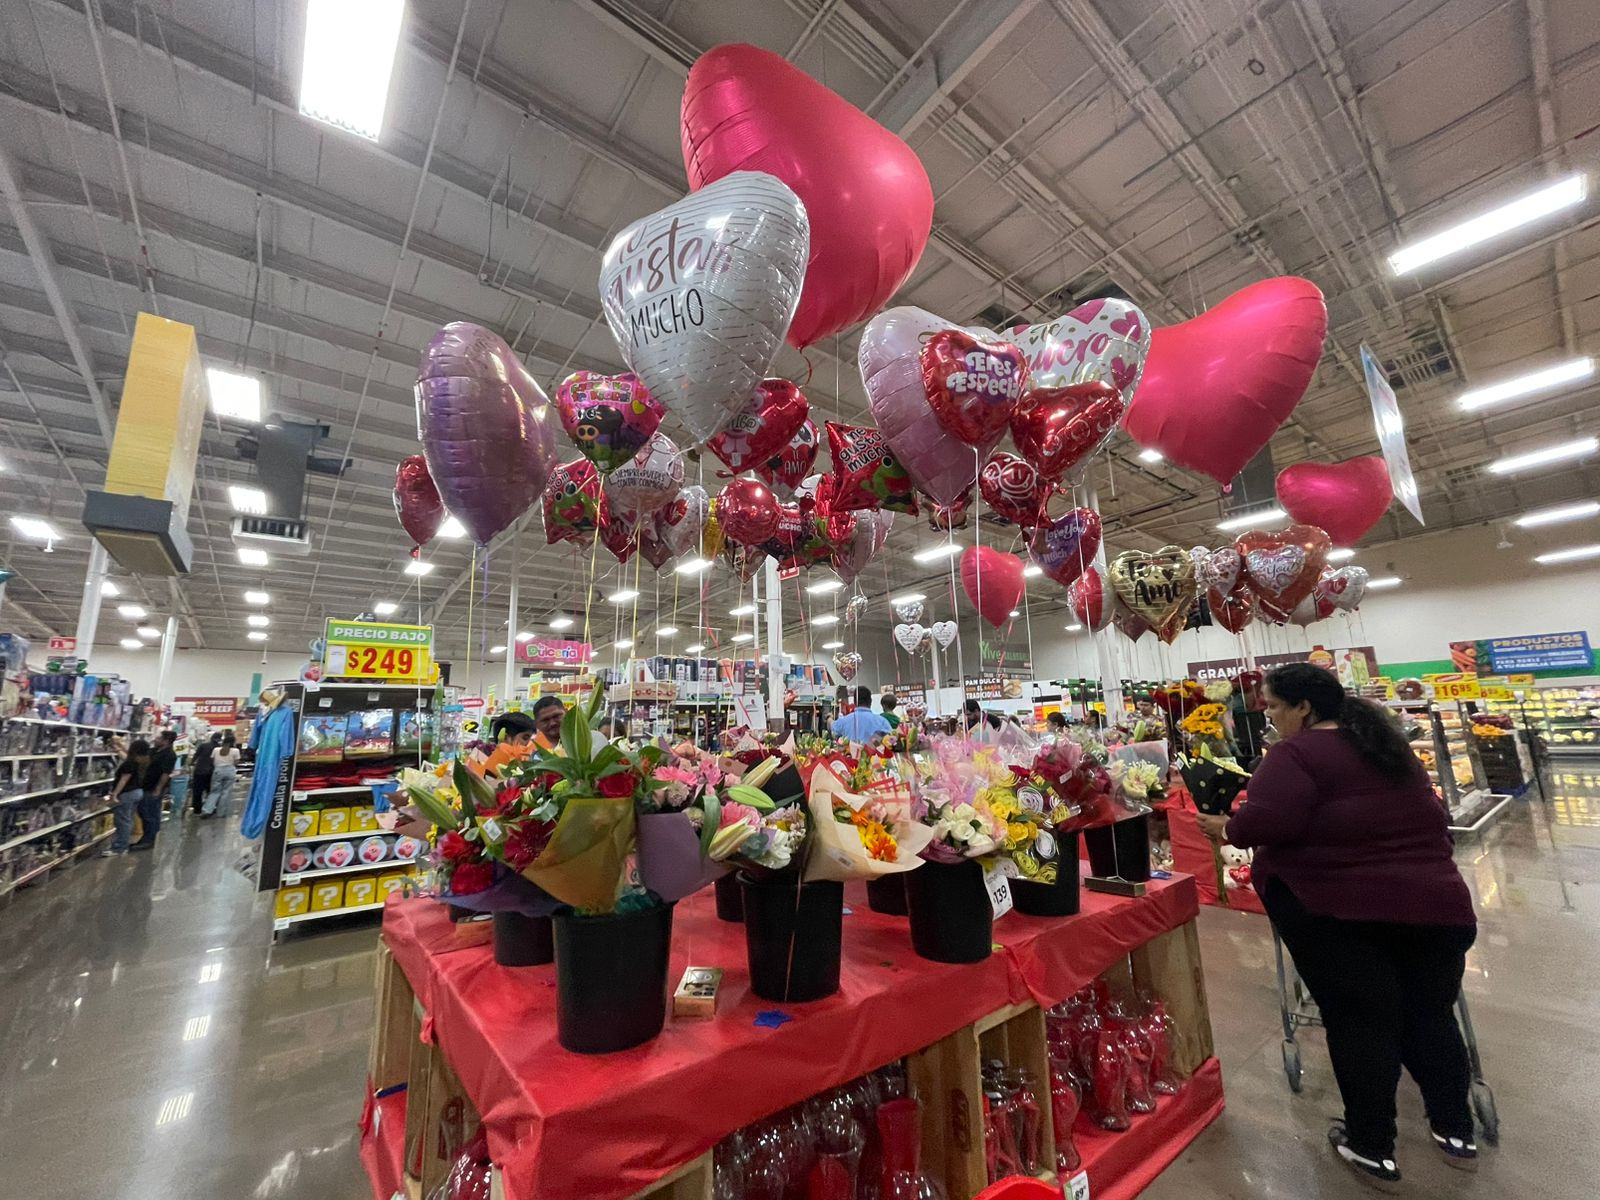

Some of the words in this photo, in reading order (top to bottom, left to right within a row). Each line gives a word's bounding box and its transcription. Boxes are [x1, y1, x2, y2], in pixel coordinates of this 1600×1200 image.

[630, 288, 704, 348] MUCHO
[839, 430, 882, 462] gusta
[1126, 559, 1151, 582] Te
[1133, 578, 1184, 606] Amo
[334, 627, 388, 640] PRECIO
[389, 631, 427, 642] BAJO
[1493, 634, 1583, 647] PRODUCTOS
[348, 647, 413, 675] $249
[270, 783, 287, 830] Consulta
